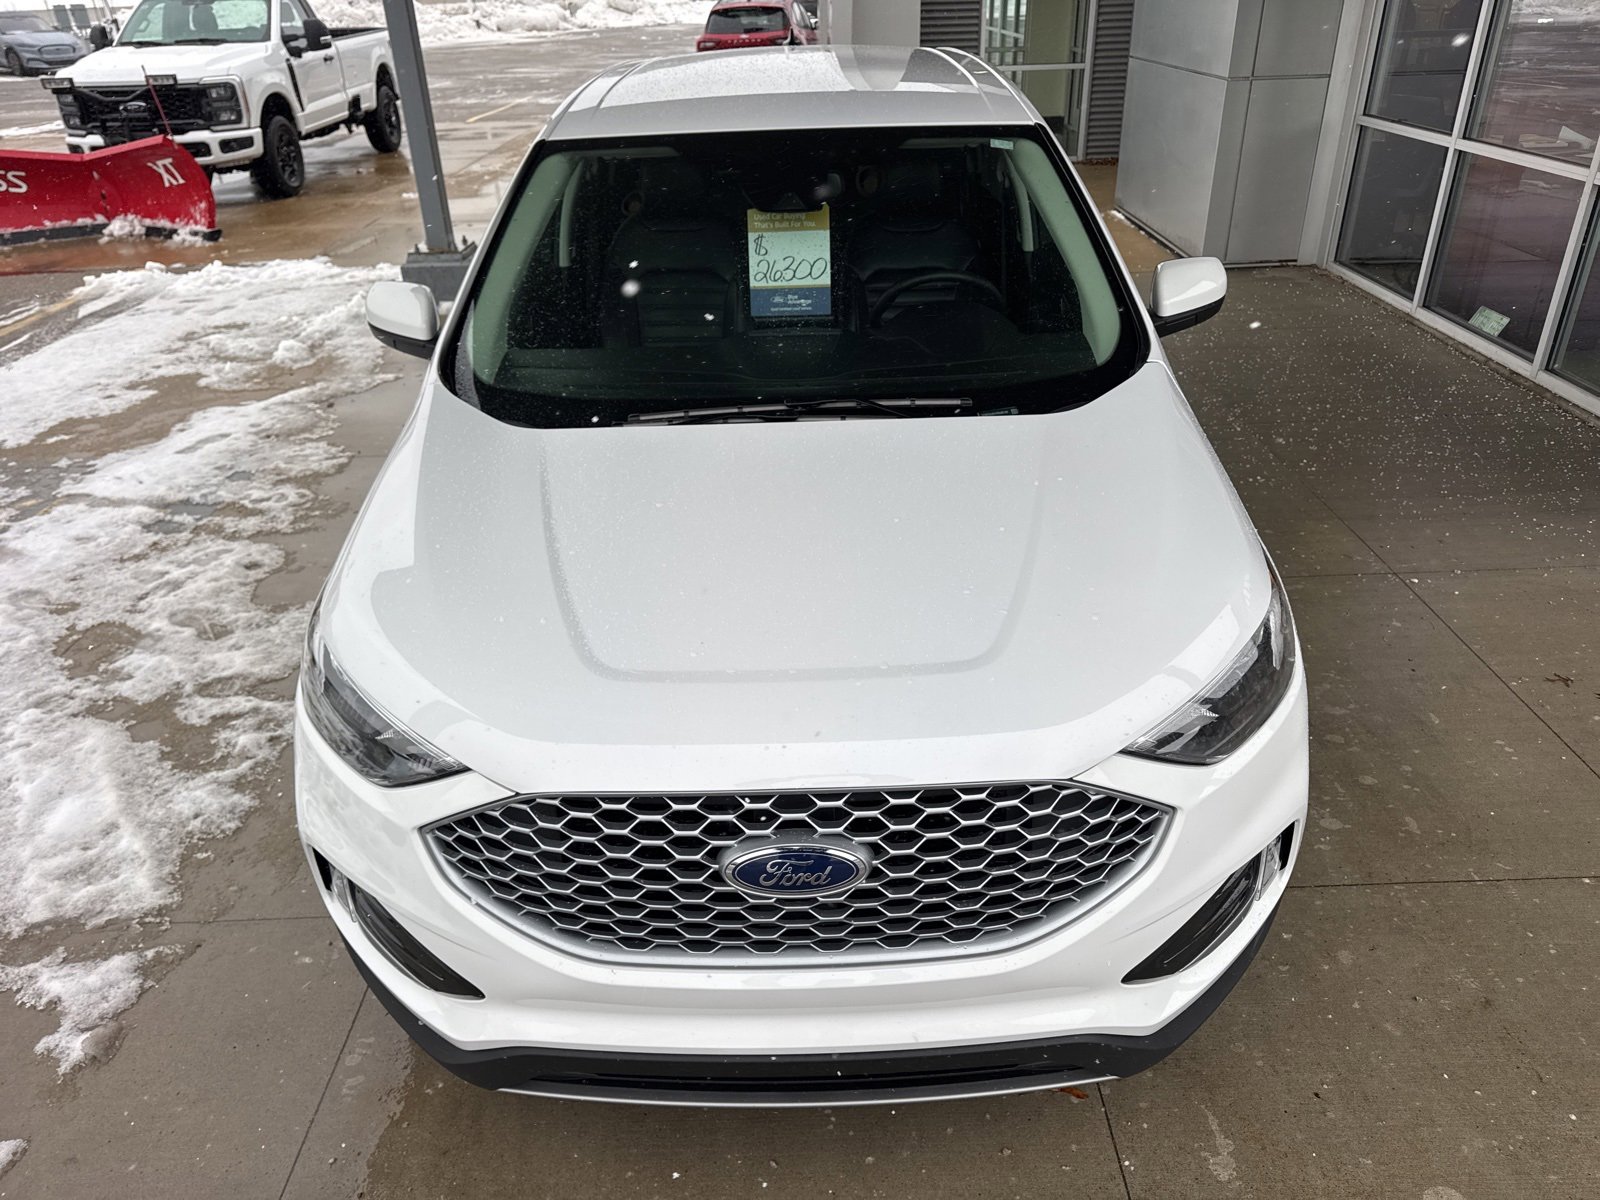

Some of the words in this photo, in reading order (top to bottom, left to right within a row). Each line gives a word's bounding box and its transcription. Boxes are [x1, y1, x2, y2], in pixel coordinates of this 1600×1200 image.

[753, 213, 770, 221] Used
[754, 221, 774, 229] That's
[775, 220, 790, 228] Built
[791, 220, 801, 228] For
[753, 233, 768, 256] $
[759, 859, 833, 887] Ford
